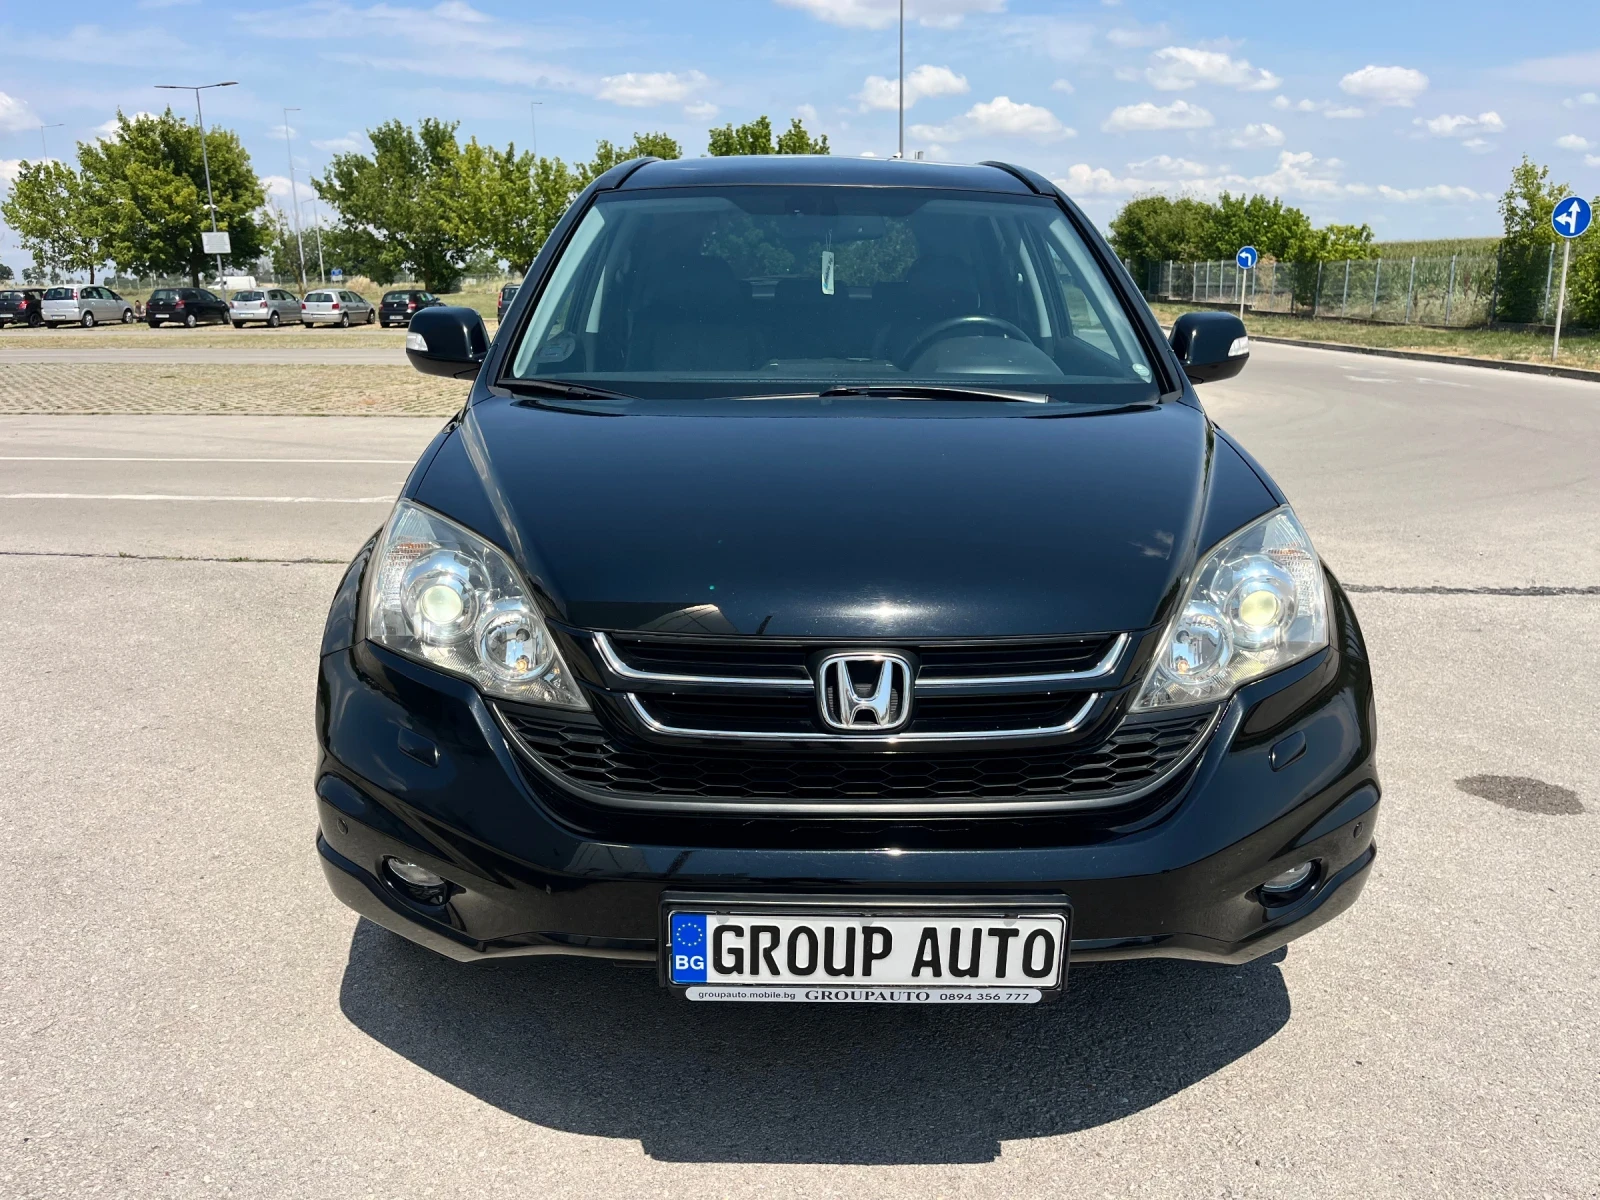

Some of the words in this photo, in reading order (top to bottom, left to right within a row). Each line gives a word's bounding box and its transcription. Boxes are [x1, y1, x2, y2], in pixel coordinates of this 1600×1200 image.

[712, 924, 893, 977] GROUP
[911, 927, 1056, 979] AUTO
[675, 955, 705, 971] BG
[698, 990, 796, 1000] groupauto.mobile.bg
[804, 990, 931, 1002] GROUPAUTO
[939, 993, 972, 1001] 0894
[976, 993, 1001, 1001] 356
[1005, 993, 1030, 1001] 777
